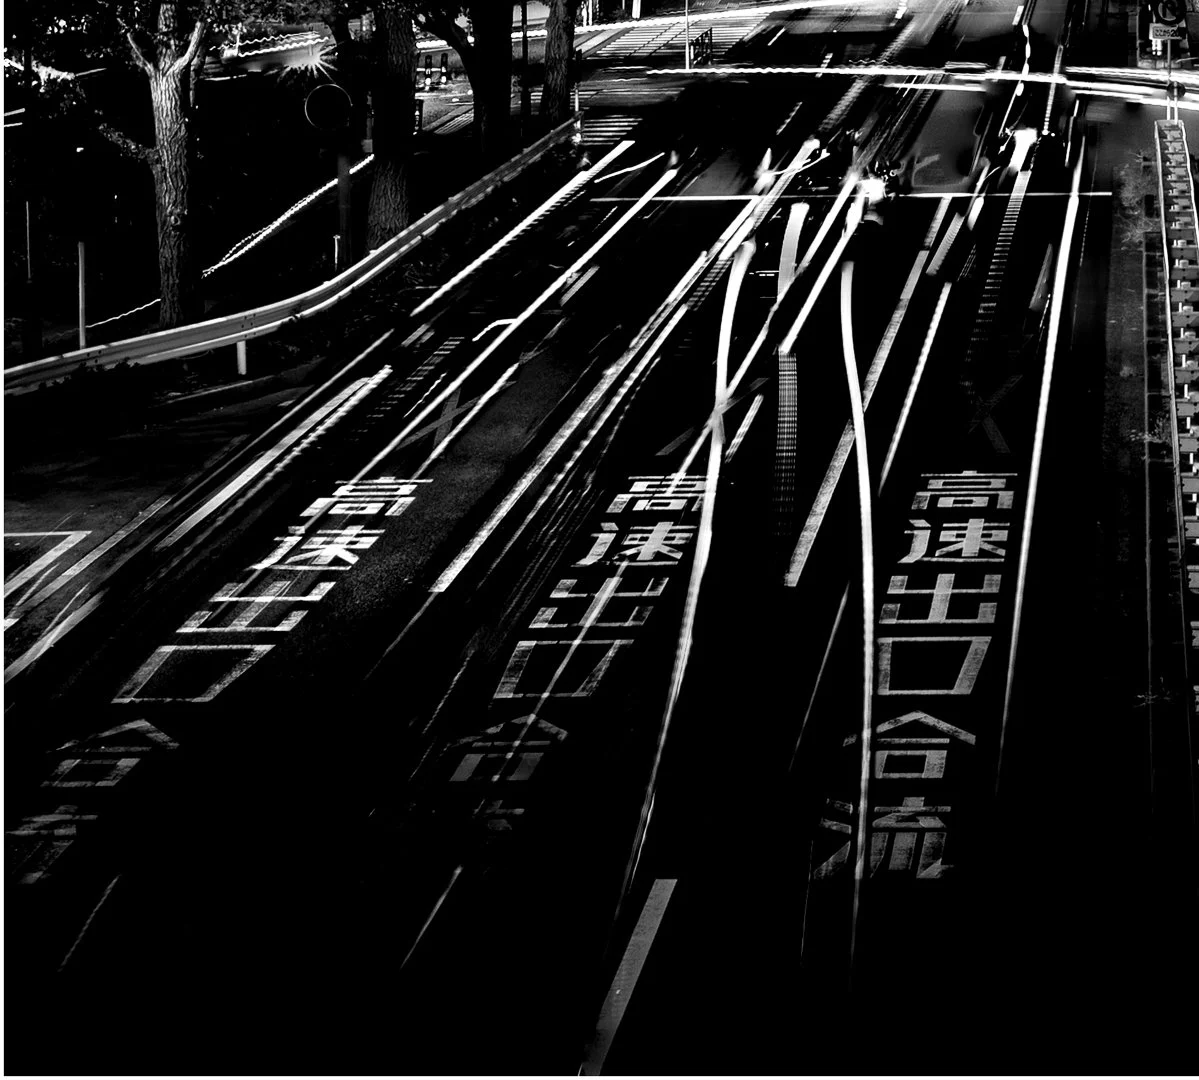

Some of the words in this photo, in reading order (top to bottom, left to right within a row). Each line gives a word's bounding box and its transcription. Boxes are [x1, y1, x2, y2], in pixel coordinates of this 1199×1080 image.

[813, 469, 1018, 880] 高速出口合流
